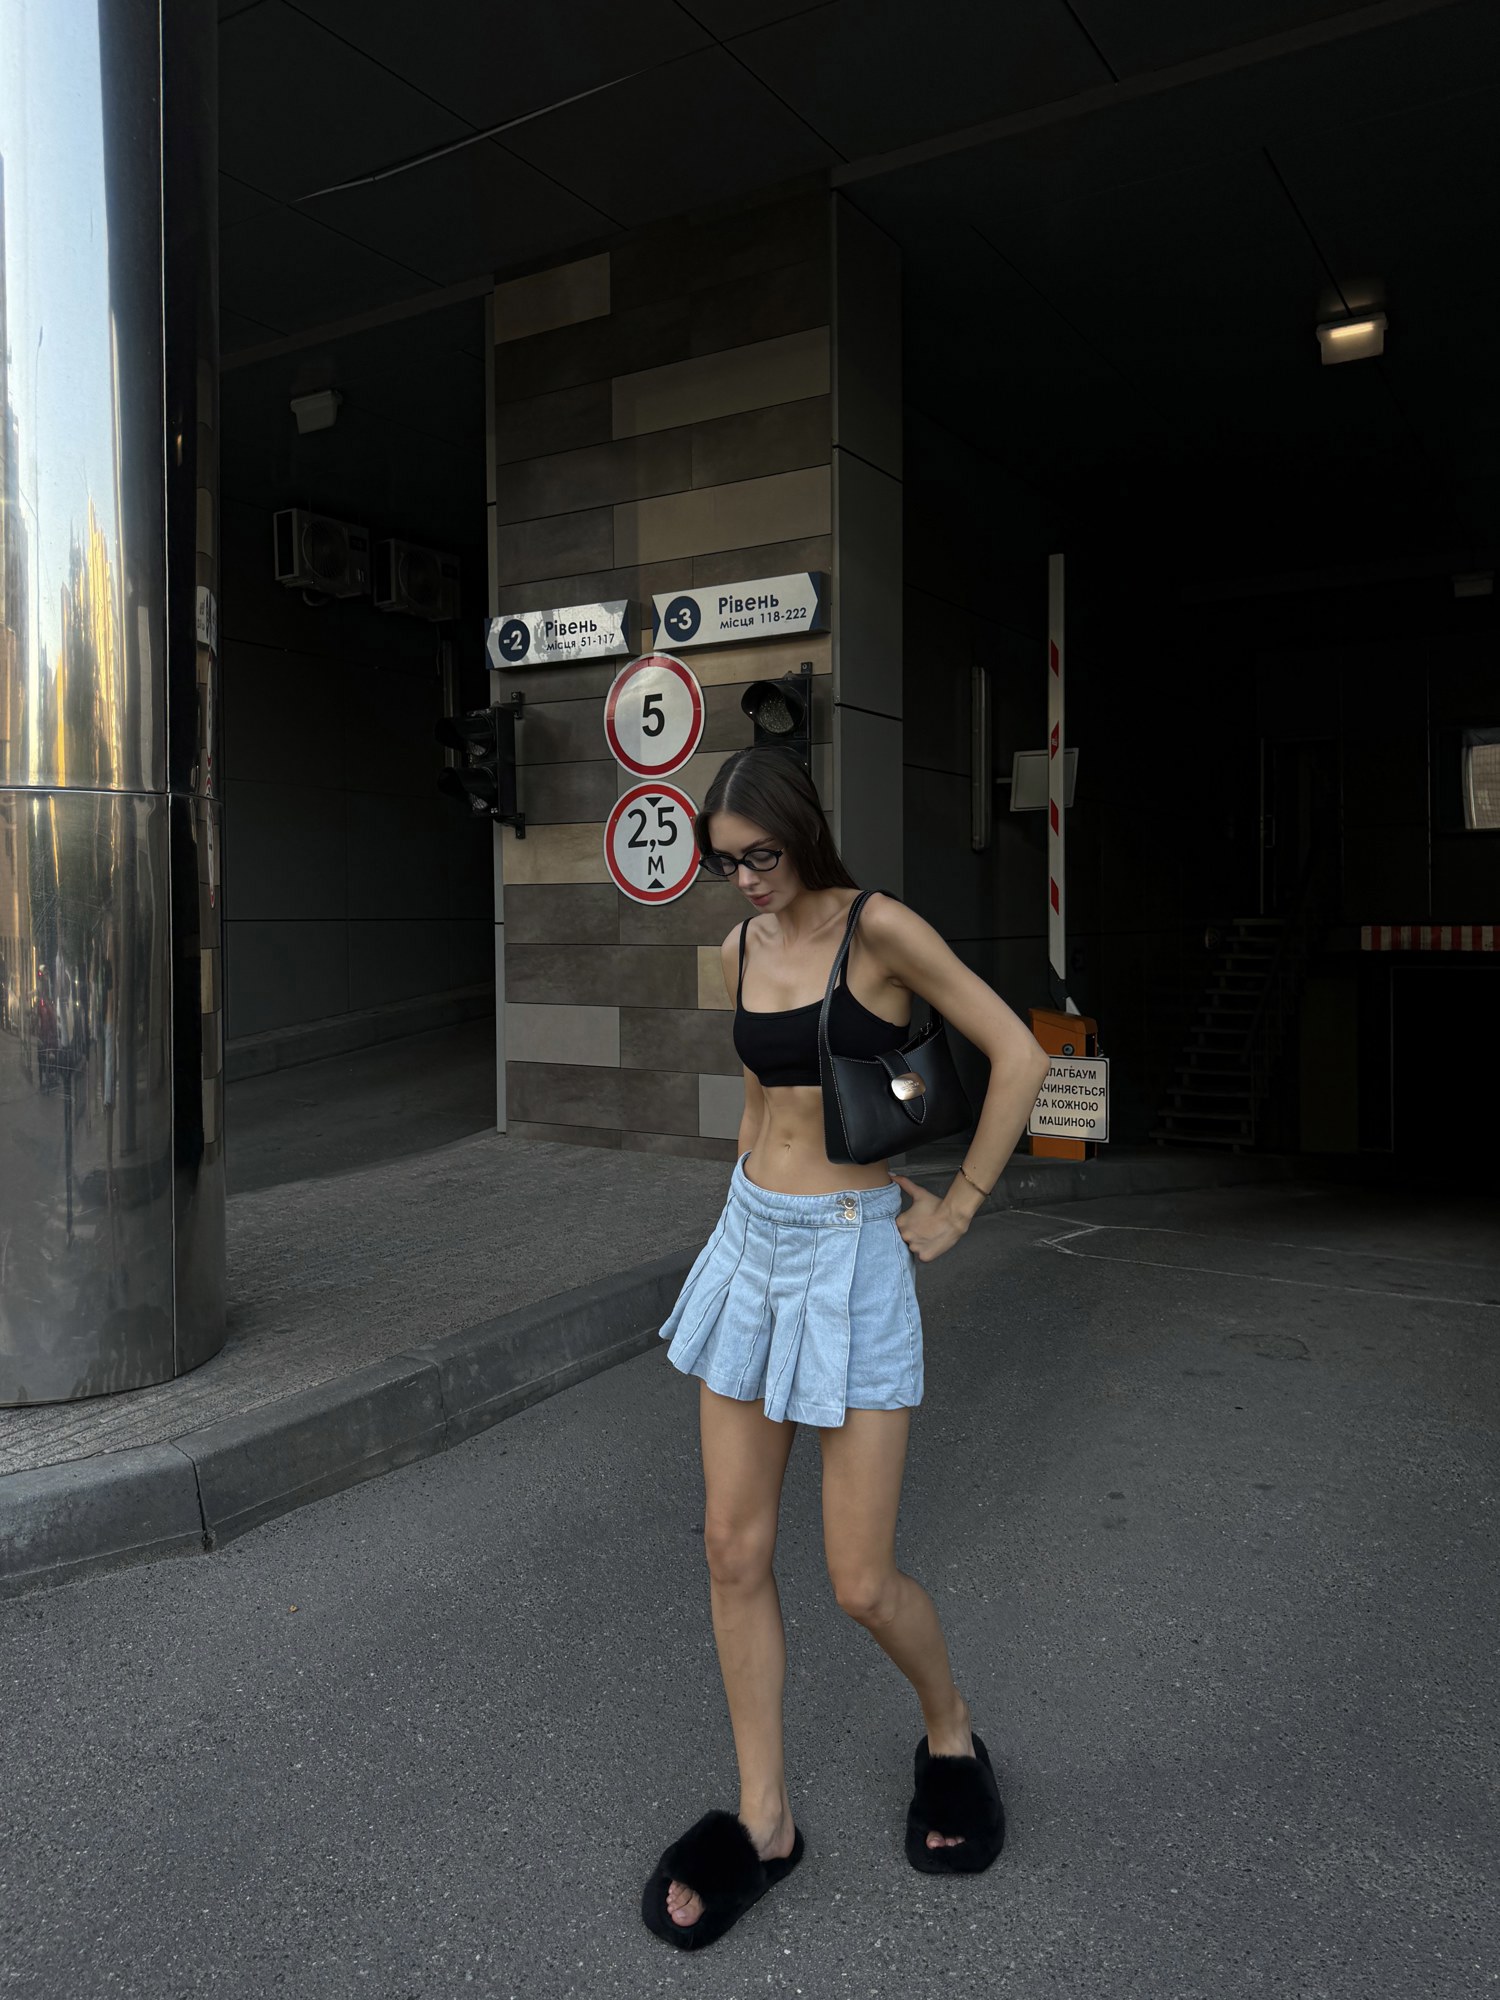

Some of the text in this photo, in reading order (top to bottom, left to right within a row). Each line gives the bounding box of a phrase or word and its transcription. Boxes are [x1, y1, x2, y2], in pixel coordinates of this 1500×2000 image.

[718, 594, 779, 615] Рівень
[545, 619, 598, 638] Рівень
[670, 607, 692, 630] -3
[719, 607, 807, 630] місця 118-222
[503, 630, 523, 651] -2
[546, 633, 615, 651] місця 51-117
[641, 693, 665, 737] 5
[1046, 1067, 1097, 1080] ЛАГБАУМ
[1036, 1098, 1099, 1112] ЗА КОЖНОЮ
[1039, 1115, 1096, 1129] МАШИНОЮ
